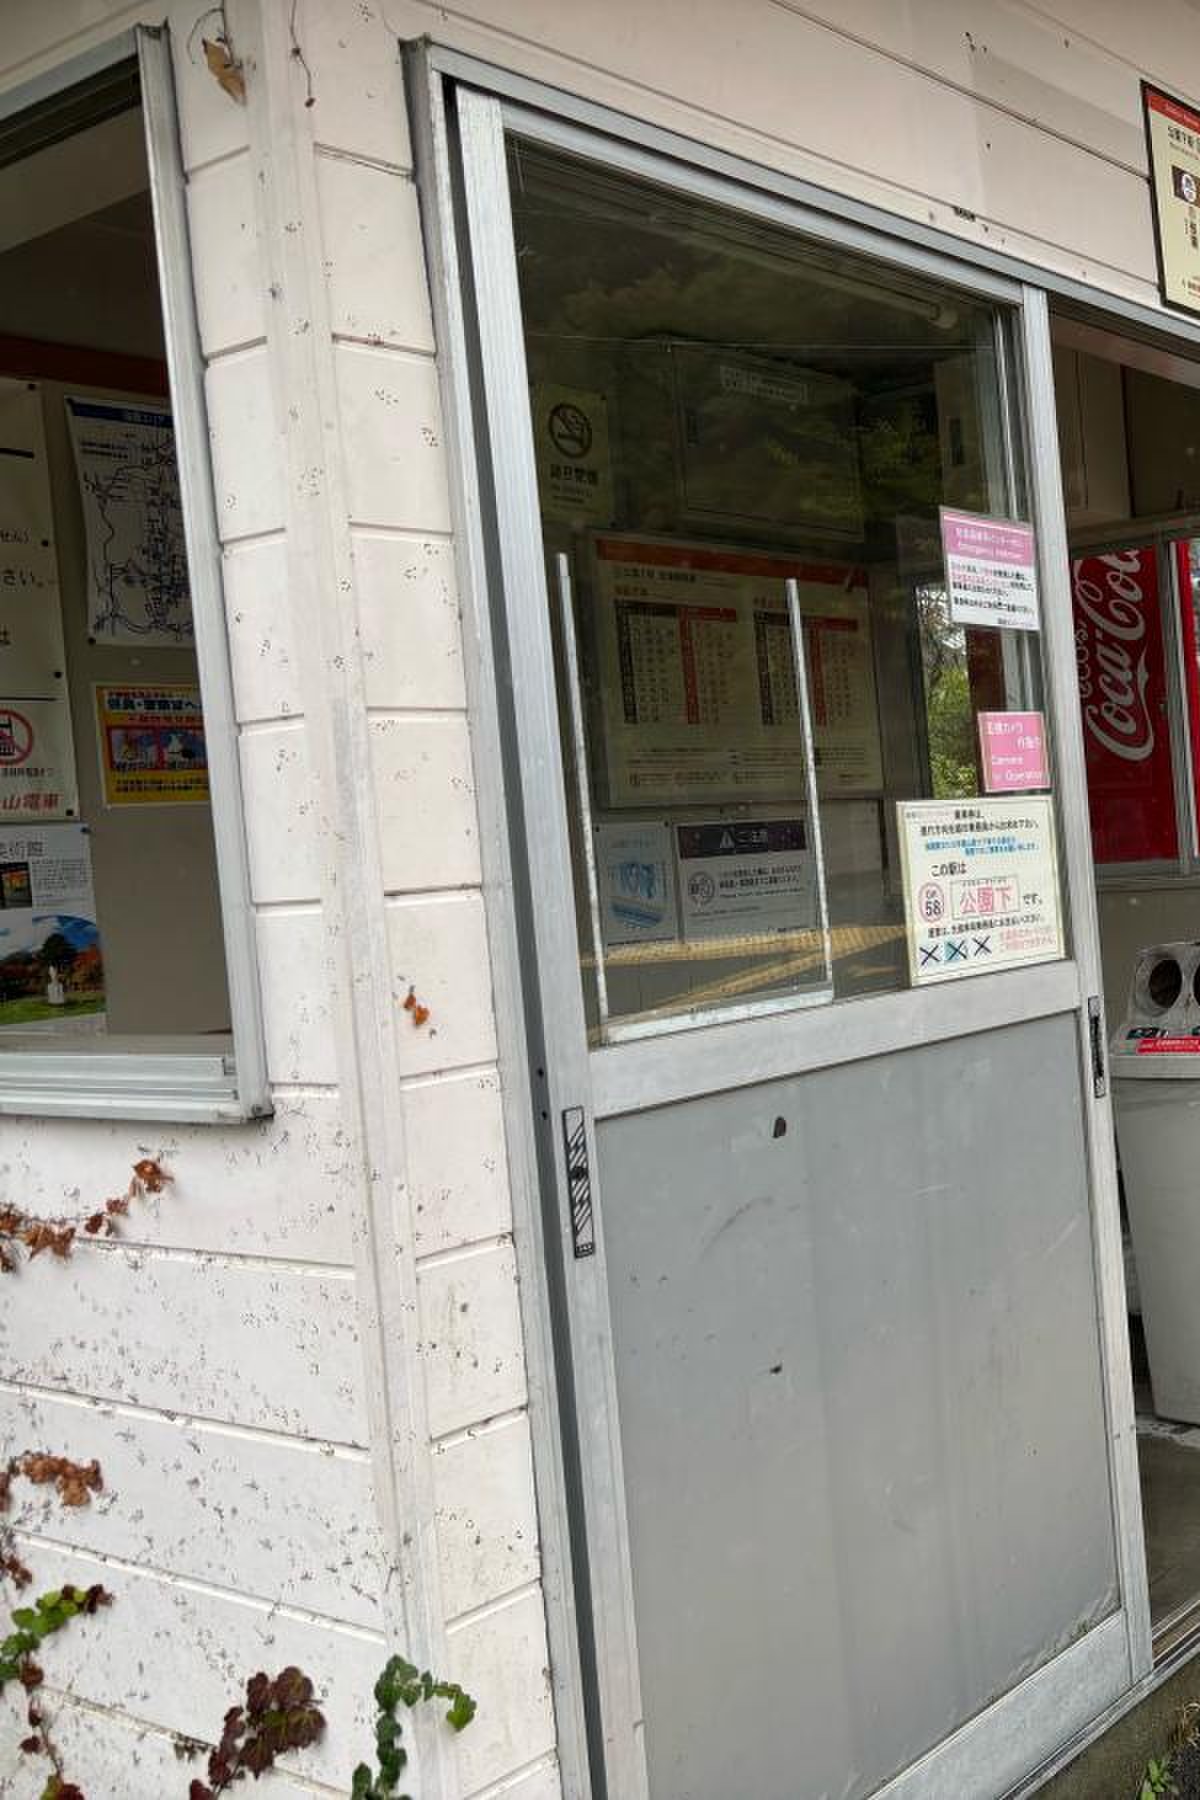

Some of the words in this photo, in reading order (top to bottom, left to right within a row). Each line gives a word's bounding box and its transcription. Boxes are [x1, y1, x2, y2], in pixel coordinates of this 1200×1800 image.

[931, 862, 967, 877] この駅は
[925, 900, 941, 917] 58
[960, 886, 1013, 916] 公園下
